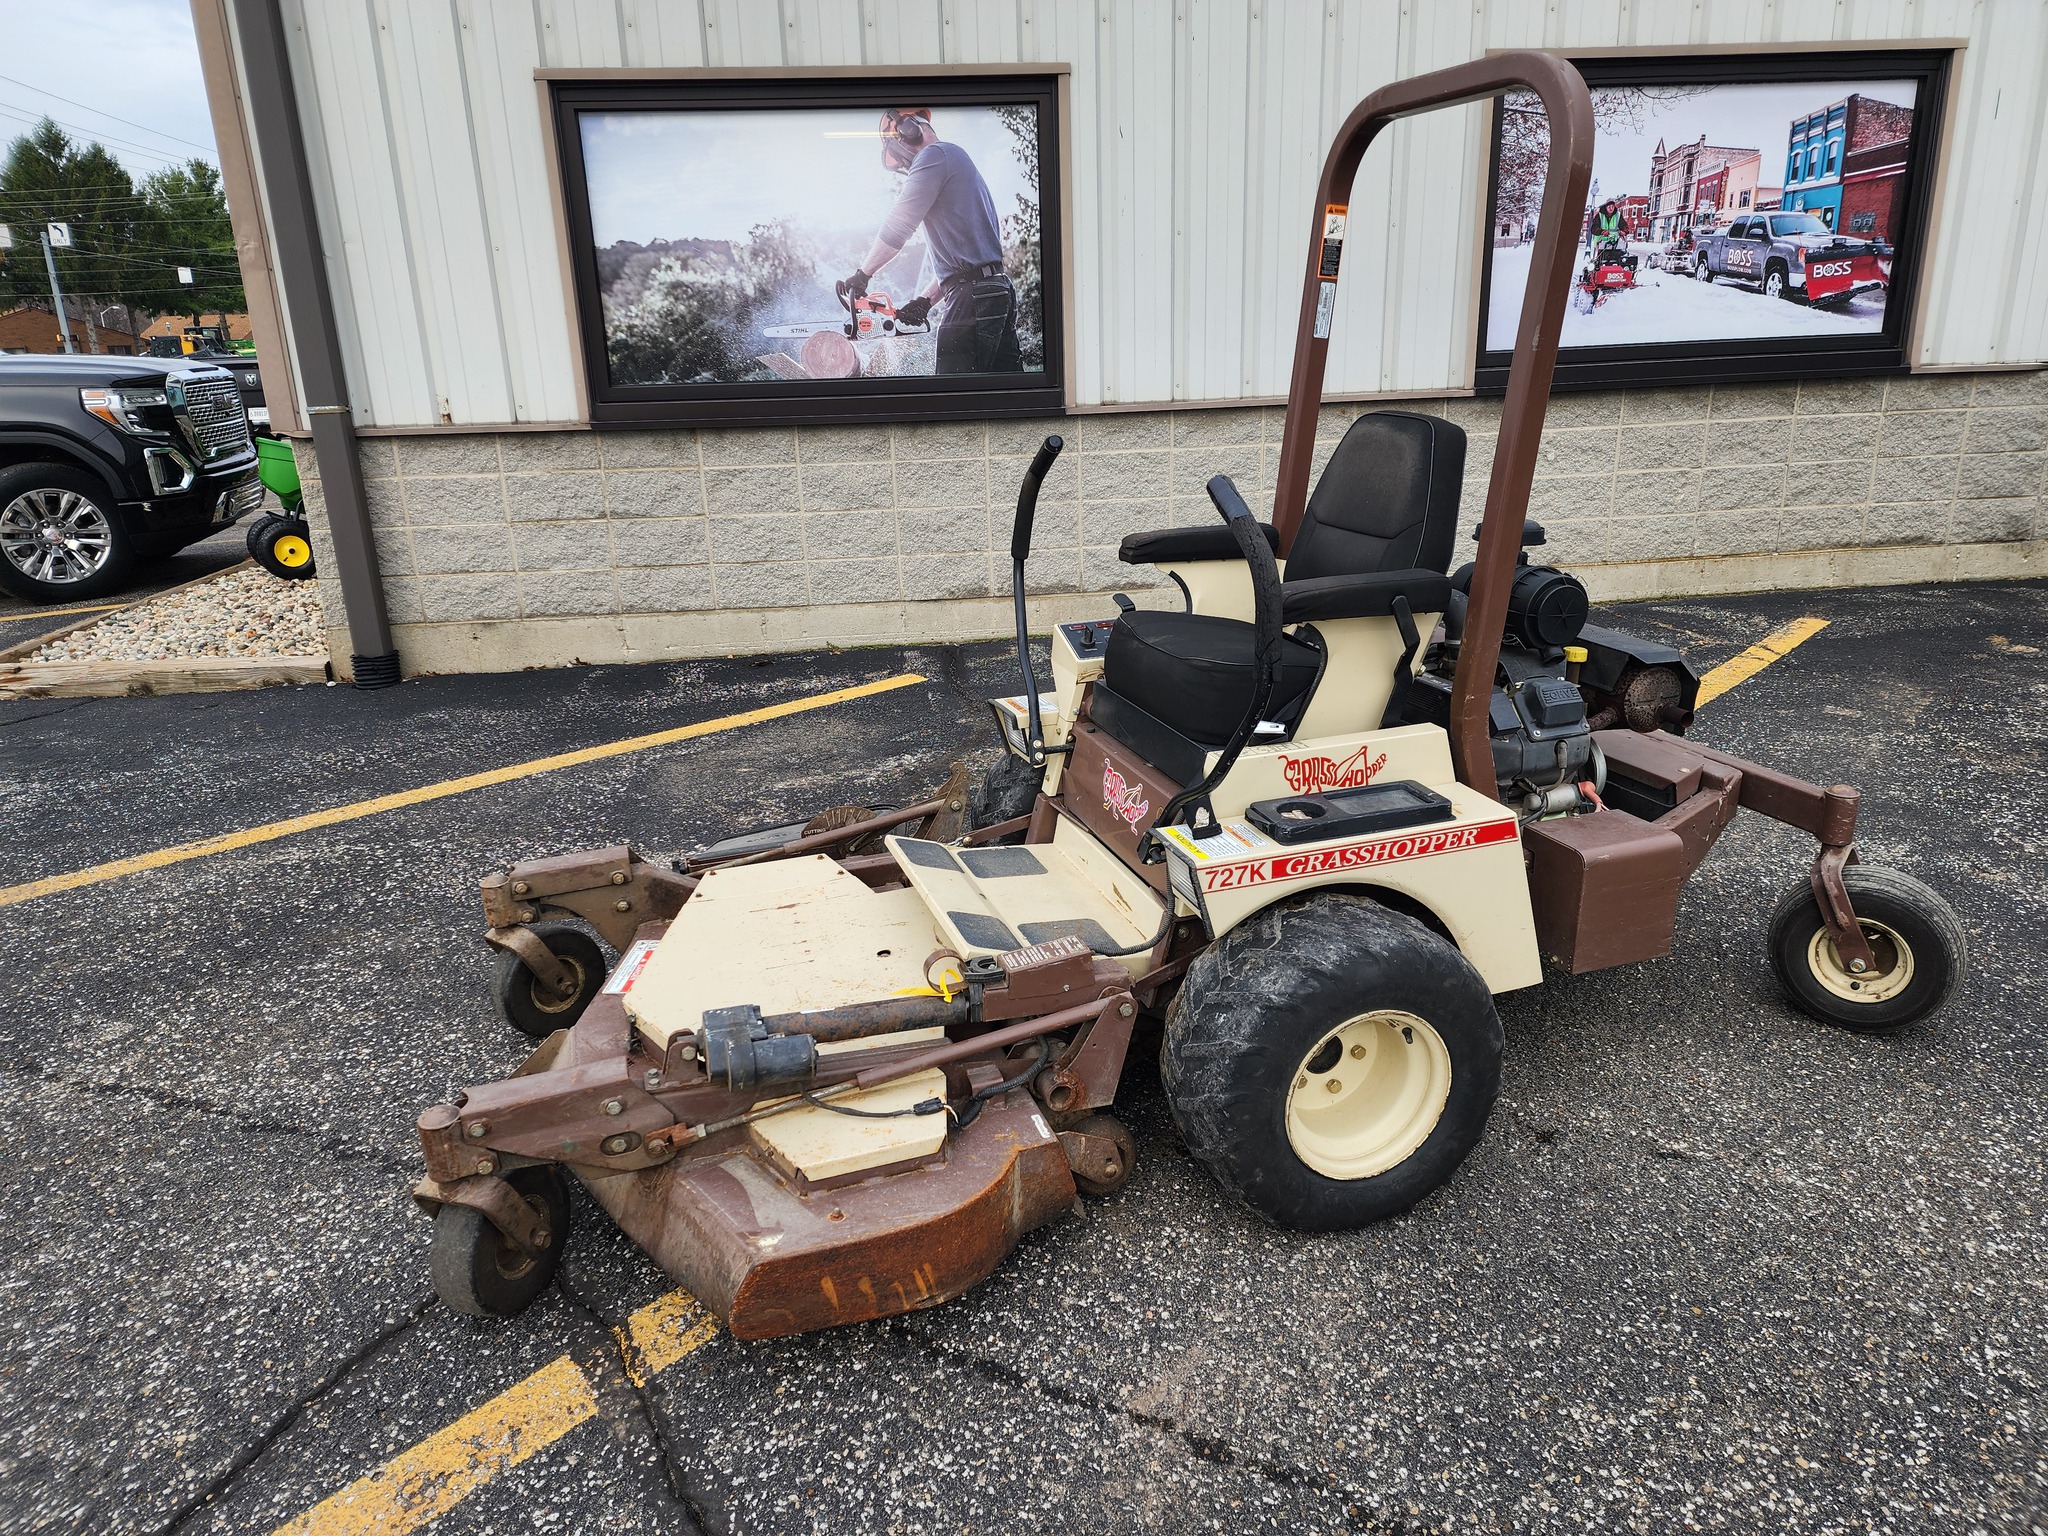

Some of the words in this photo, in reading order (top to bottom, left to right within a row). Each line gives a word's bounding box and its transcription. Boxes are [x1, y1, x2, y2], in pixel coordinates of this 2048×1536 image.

[1727, 248, 1754, 267] BOSS
[1812, 261, 1853, 279] BOSS
[1550, 689, 1571, 700] OHV
[1205, 860, 1267, 890] 727K
[1285, 828, 1479, 875] GRASSHOPPER
